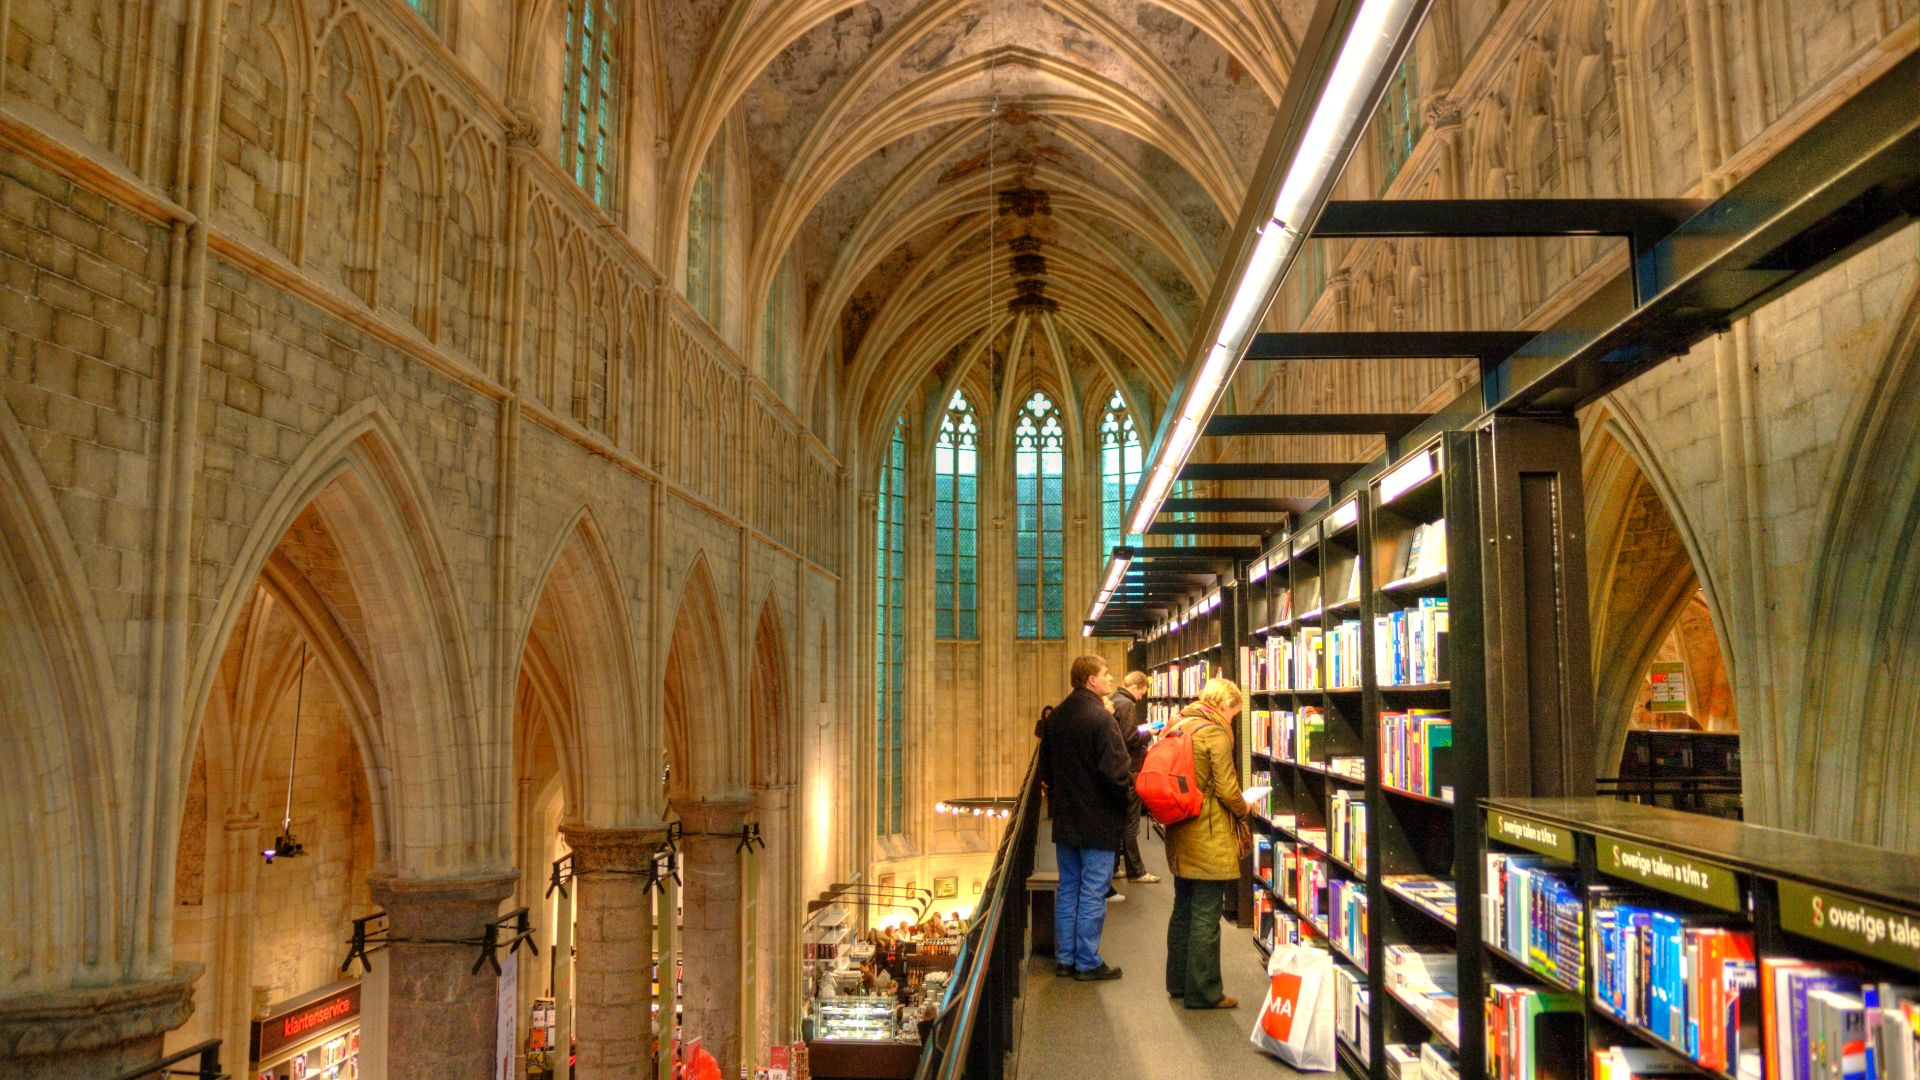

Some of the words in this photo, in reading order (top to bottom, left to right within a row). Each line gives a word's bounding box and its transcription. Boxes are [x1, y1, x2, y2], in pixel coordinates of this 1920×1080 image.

[1504, 820, 1522, 840] overige
[1522, 823, 1537, 841] talen
[1537, 830, 1541, 843] a
[1541, 827, 1553, 844] t/m
[1553, 833, 1557, 846] z
[1621, 852, 1651, 876] overige
[1652, 856, 1674, 879] talen
[1675, 866, 1681, 881] a
[1682, 864, 1701, 886] t/m
[1701, 873, 1708, 889] z
[1828, 907, 1885, 944] overige
[285, 997, 350, 1037] klantenservice
